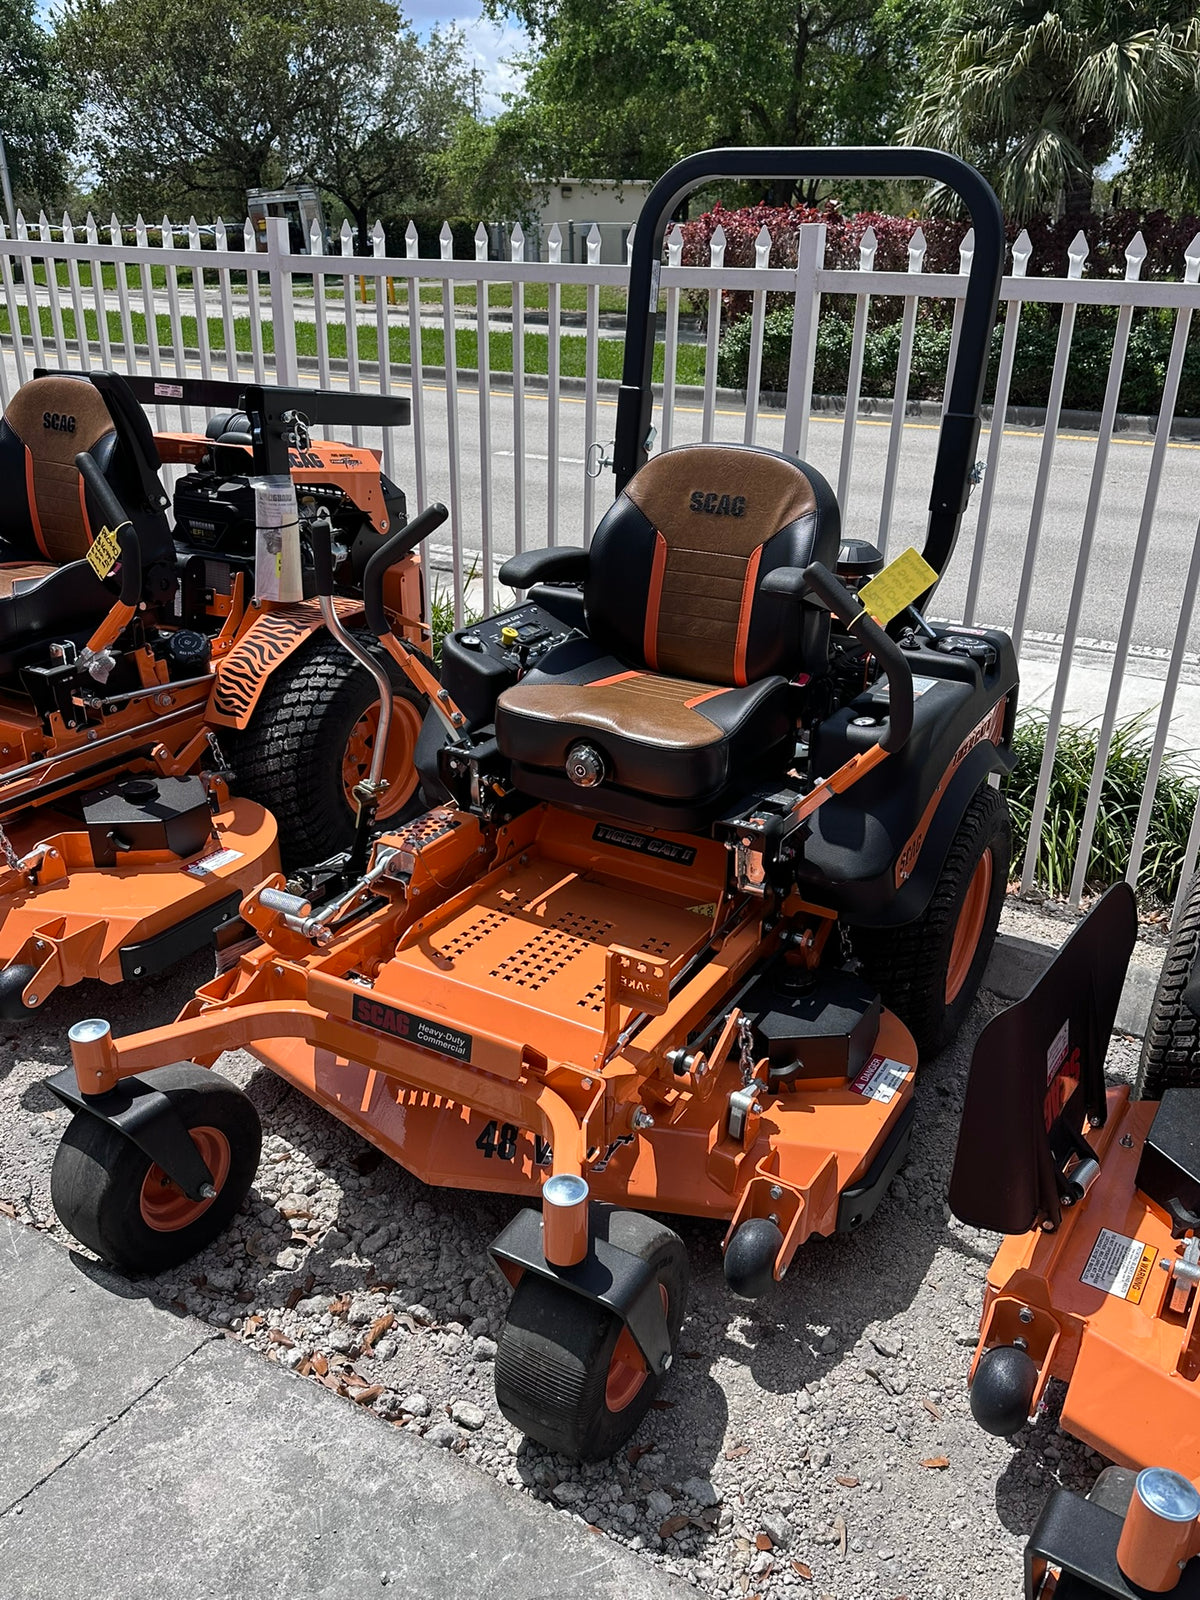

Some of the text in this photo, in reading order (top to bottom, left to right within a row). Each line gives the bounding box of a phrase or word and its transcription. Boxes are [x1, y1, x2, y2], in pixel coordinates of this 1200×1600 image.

[43, 412, 76, 433] SCAG
[288, 453, 325, 469] CAG
[689, 491, 746, 517] SCAG
[597, 826, 646, 848] TIGER
[647, 840, 683, 857] CAT
[900, 833, 922, 872] SCAG
[358, 1000, 410, 1036] SCAG
[417, 1031, 466, 1055] Commercial
[418, 1023, 466, 1047] Heavy-Duty
[860, 1058, 882, 1082] DANGER
[475, 1120, 519, 1160] 48
